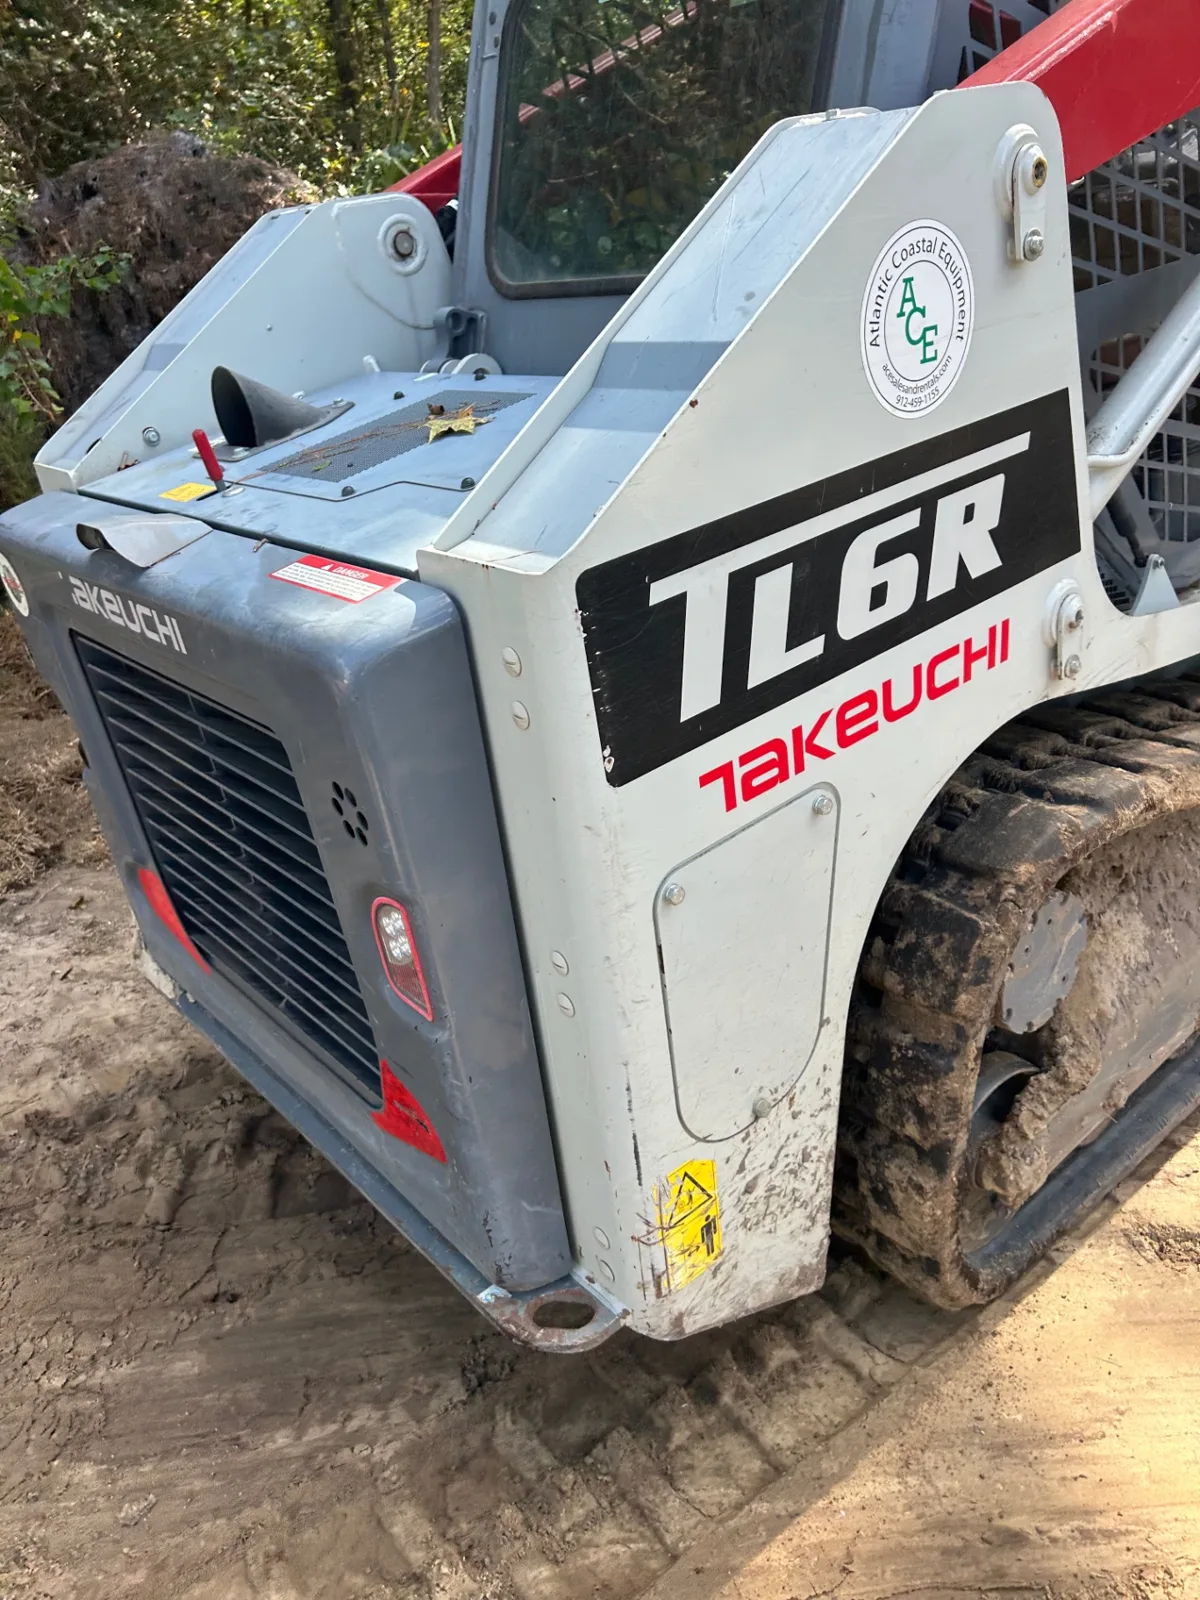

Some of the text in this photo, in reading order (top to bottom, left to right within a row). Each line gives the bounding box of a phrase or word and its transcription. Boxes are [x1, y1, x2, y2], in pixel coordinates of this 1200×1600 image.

[869, 236, 965, 347] Atlantic Coastal Equipment
[896, 276, 938, 364] ACE
[882, 355, 953, 395] acesalesandrentals.com
[895, 387, 940, 408] 912-459-1155
[58, 571, 188, 655] AKEUCHI
[332, 565, 370, 580] DANGER
[648, 431, 1031, 723] TL6R
